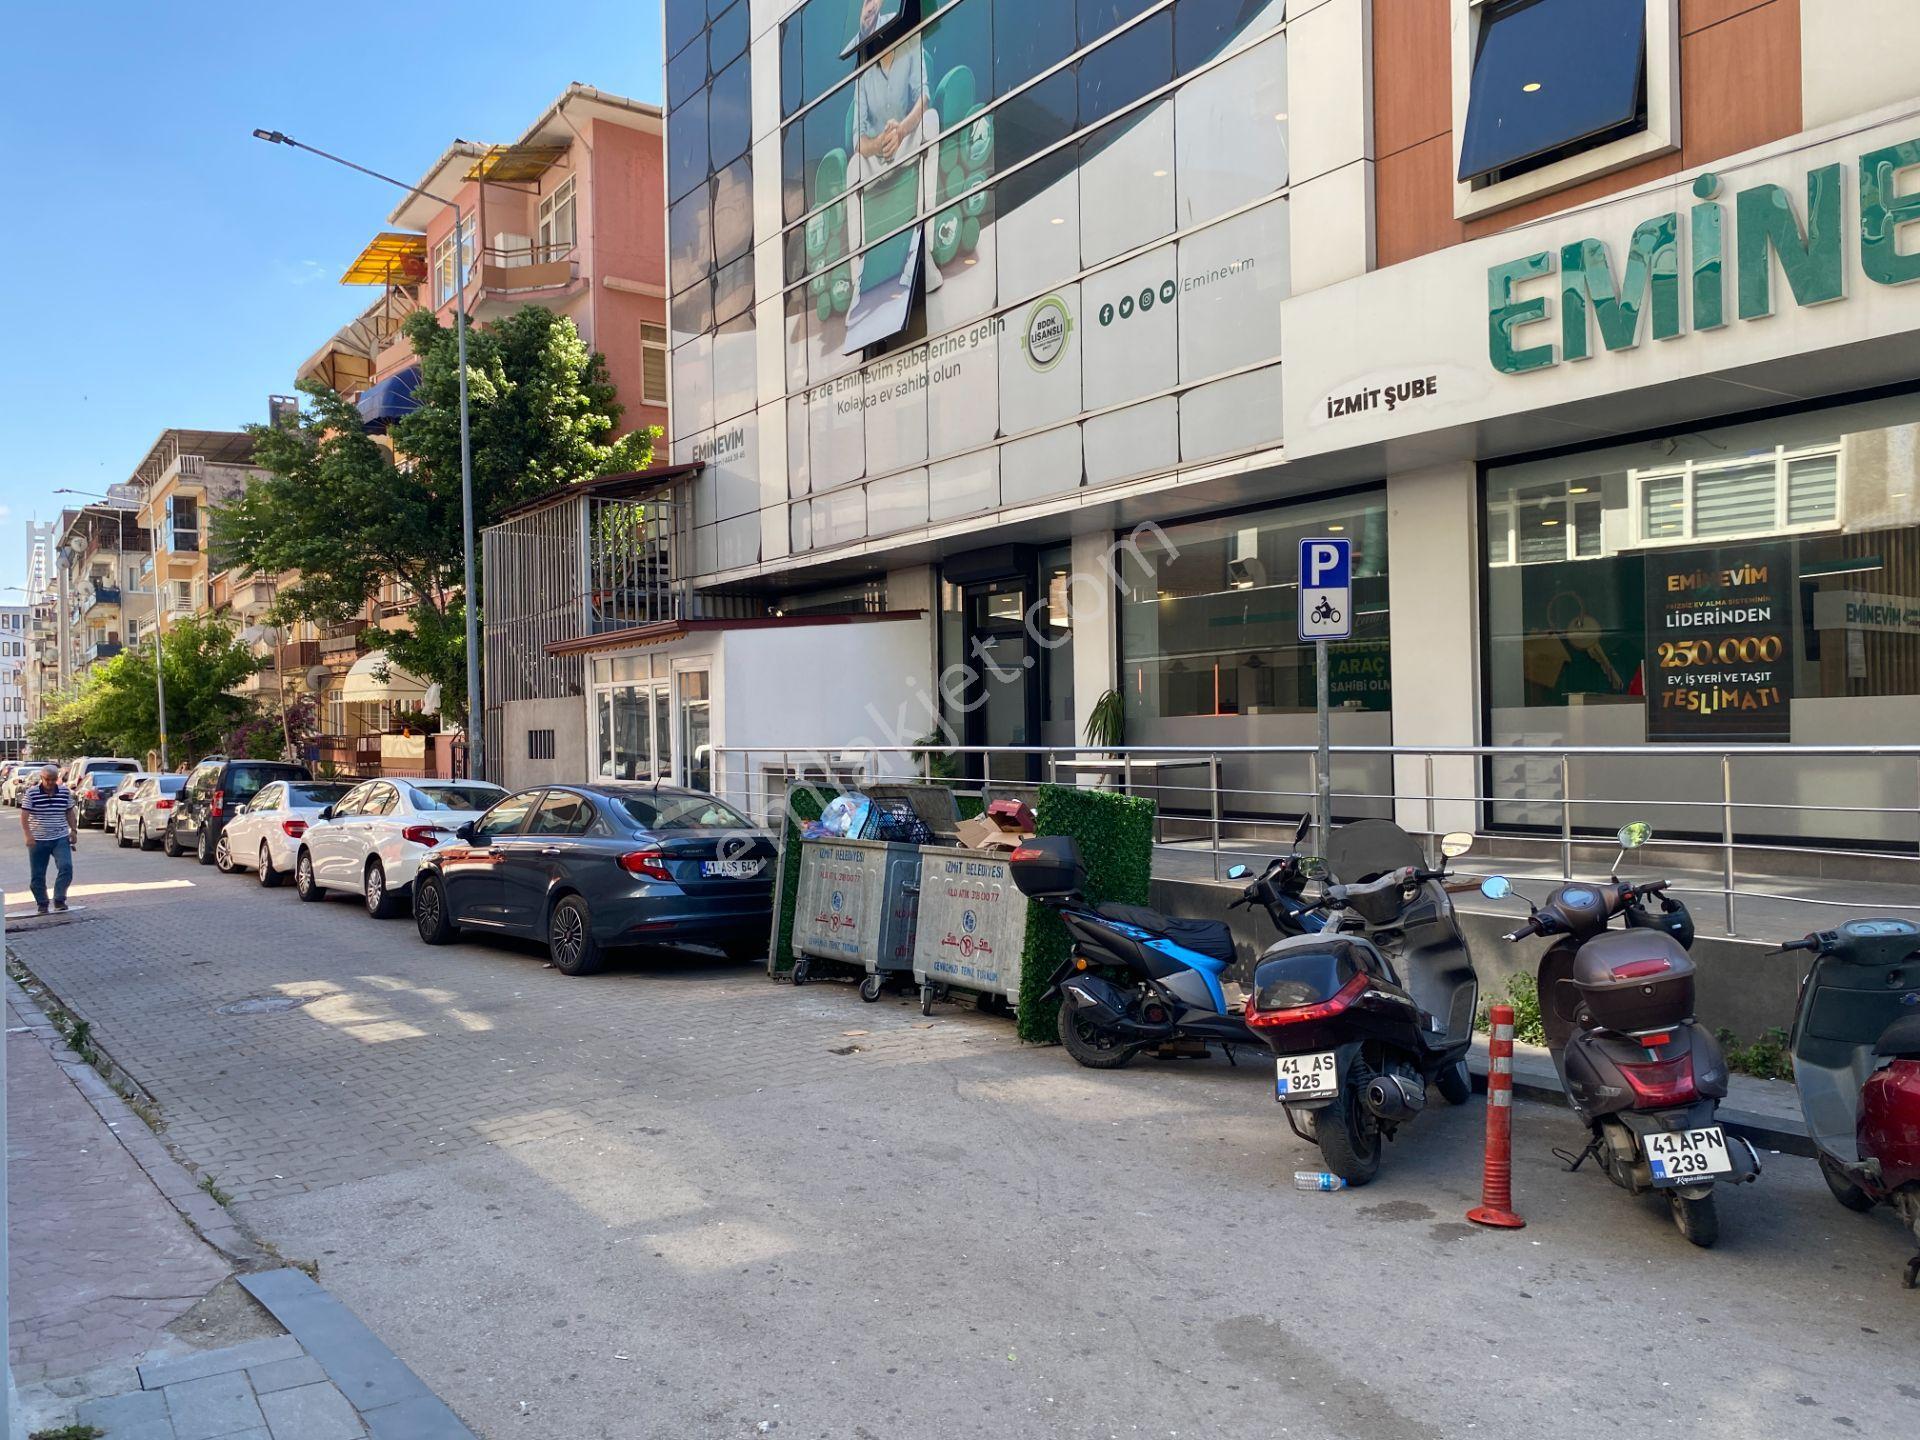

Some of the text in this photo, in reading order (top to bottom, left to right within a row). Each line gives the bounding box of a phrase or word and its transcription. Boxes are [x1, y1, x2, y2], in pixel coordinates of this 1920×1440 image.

[1487, 138, 1920, 375] EMİNE
[1031, 324, 1062, 343] LİSANSLI
[1037, 316, 1056, 330] BDDK
[819, 382, 833, 399] de
[896, 336, 966, 378] şubelerine
[970, 316, 1006, 349] gelin
[837, 361, 961, 416] Kolayca ev sahibi olun
[1327, 375, 1437, 419] İZMİT ŞUBE
[692, 426, 744, 463] EMİNEVİM
[1310, 544, 1340, 586] P
[1666, 607, 1771, 628] LİDERİNDEN
[1657, 635, 1783, 668] 250.000
[1667, 672, 1772, 686] EV, İŞ YERİ VE TAŞIT
[1662, 686, 1780, 715] TESLİMATI
[945, 860, 1004, 879] İZMİT BELEDİYESİ
[1282, 1056, 1334, 1074] 41 AS
[1292, 1074, 1320, 1090] 925
[1669, 1153, 1708, 1174] 239
